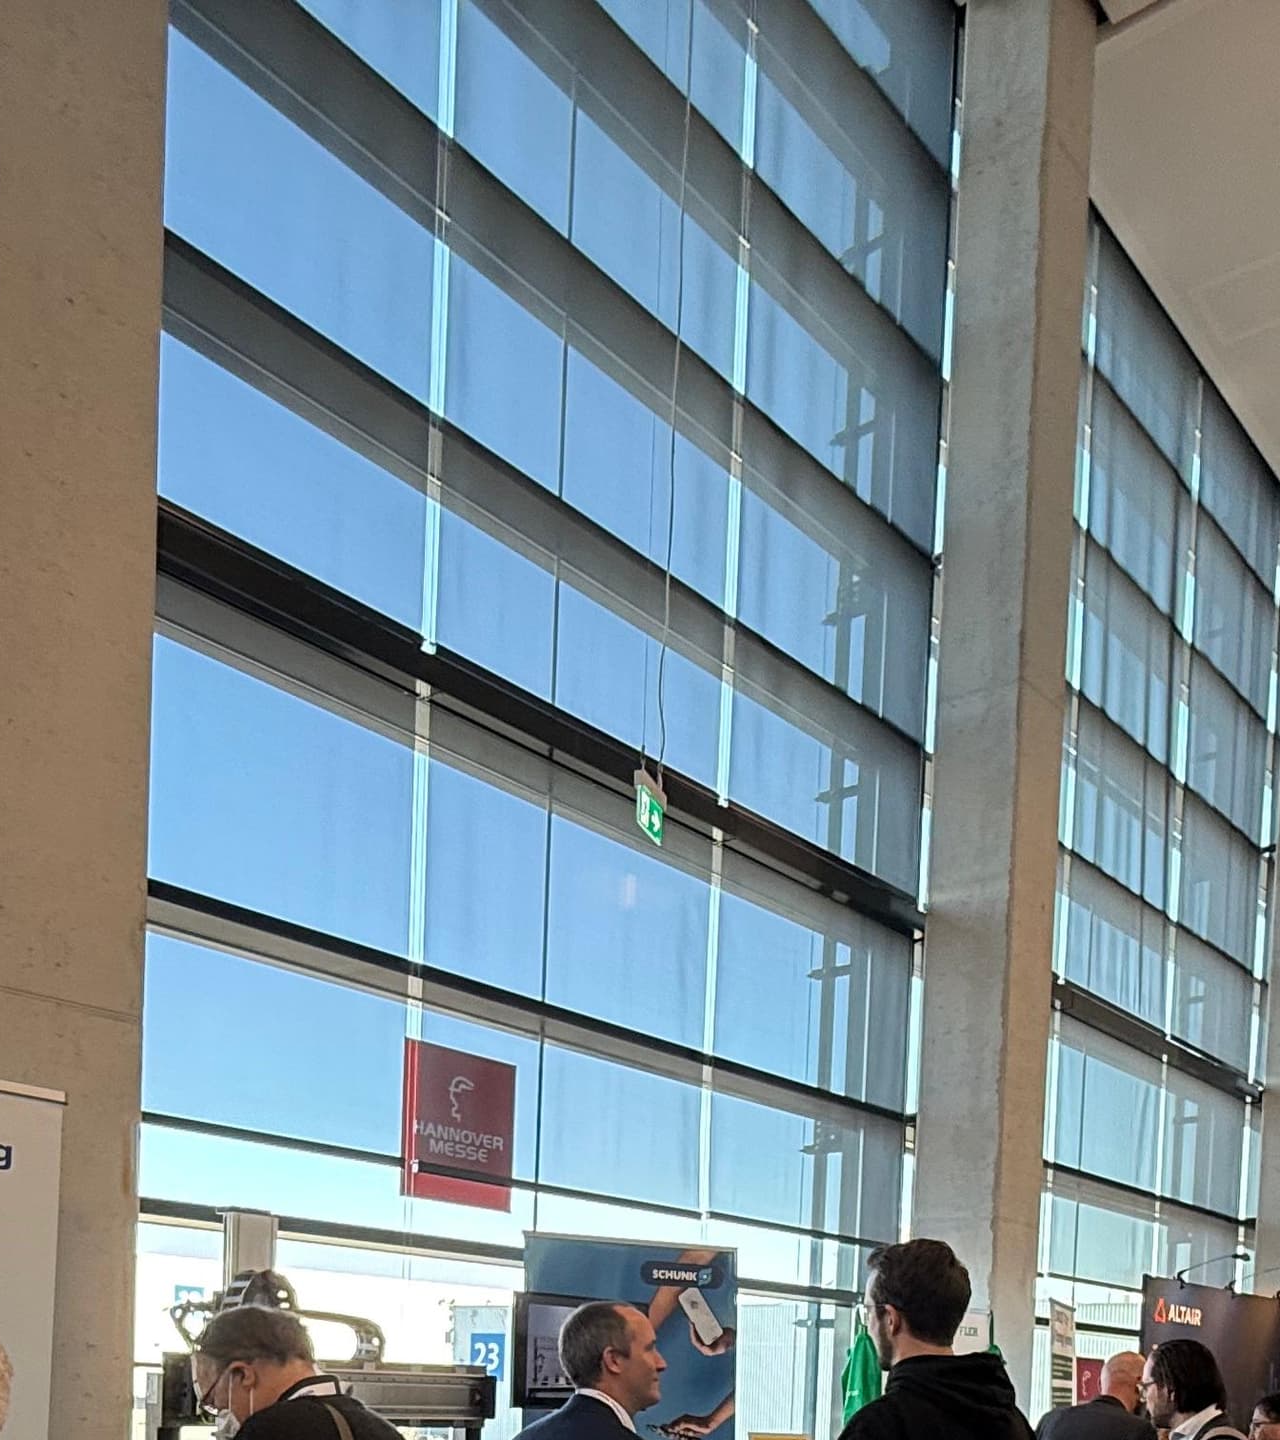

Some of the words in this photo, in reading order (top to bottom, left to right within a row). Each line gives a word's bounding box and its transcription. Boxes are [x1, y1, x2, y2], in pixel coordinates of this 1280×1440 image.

[413, 1119, 505, 1151] HANNOVER
[429, 1138, 489, 1163] MESSE
[652, 1268, 698, 1282] SCHUNK
[1168, 1303, 1202, 1327] ALTAIR
[474, 1342, 499, 1372] 23
